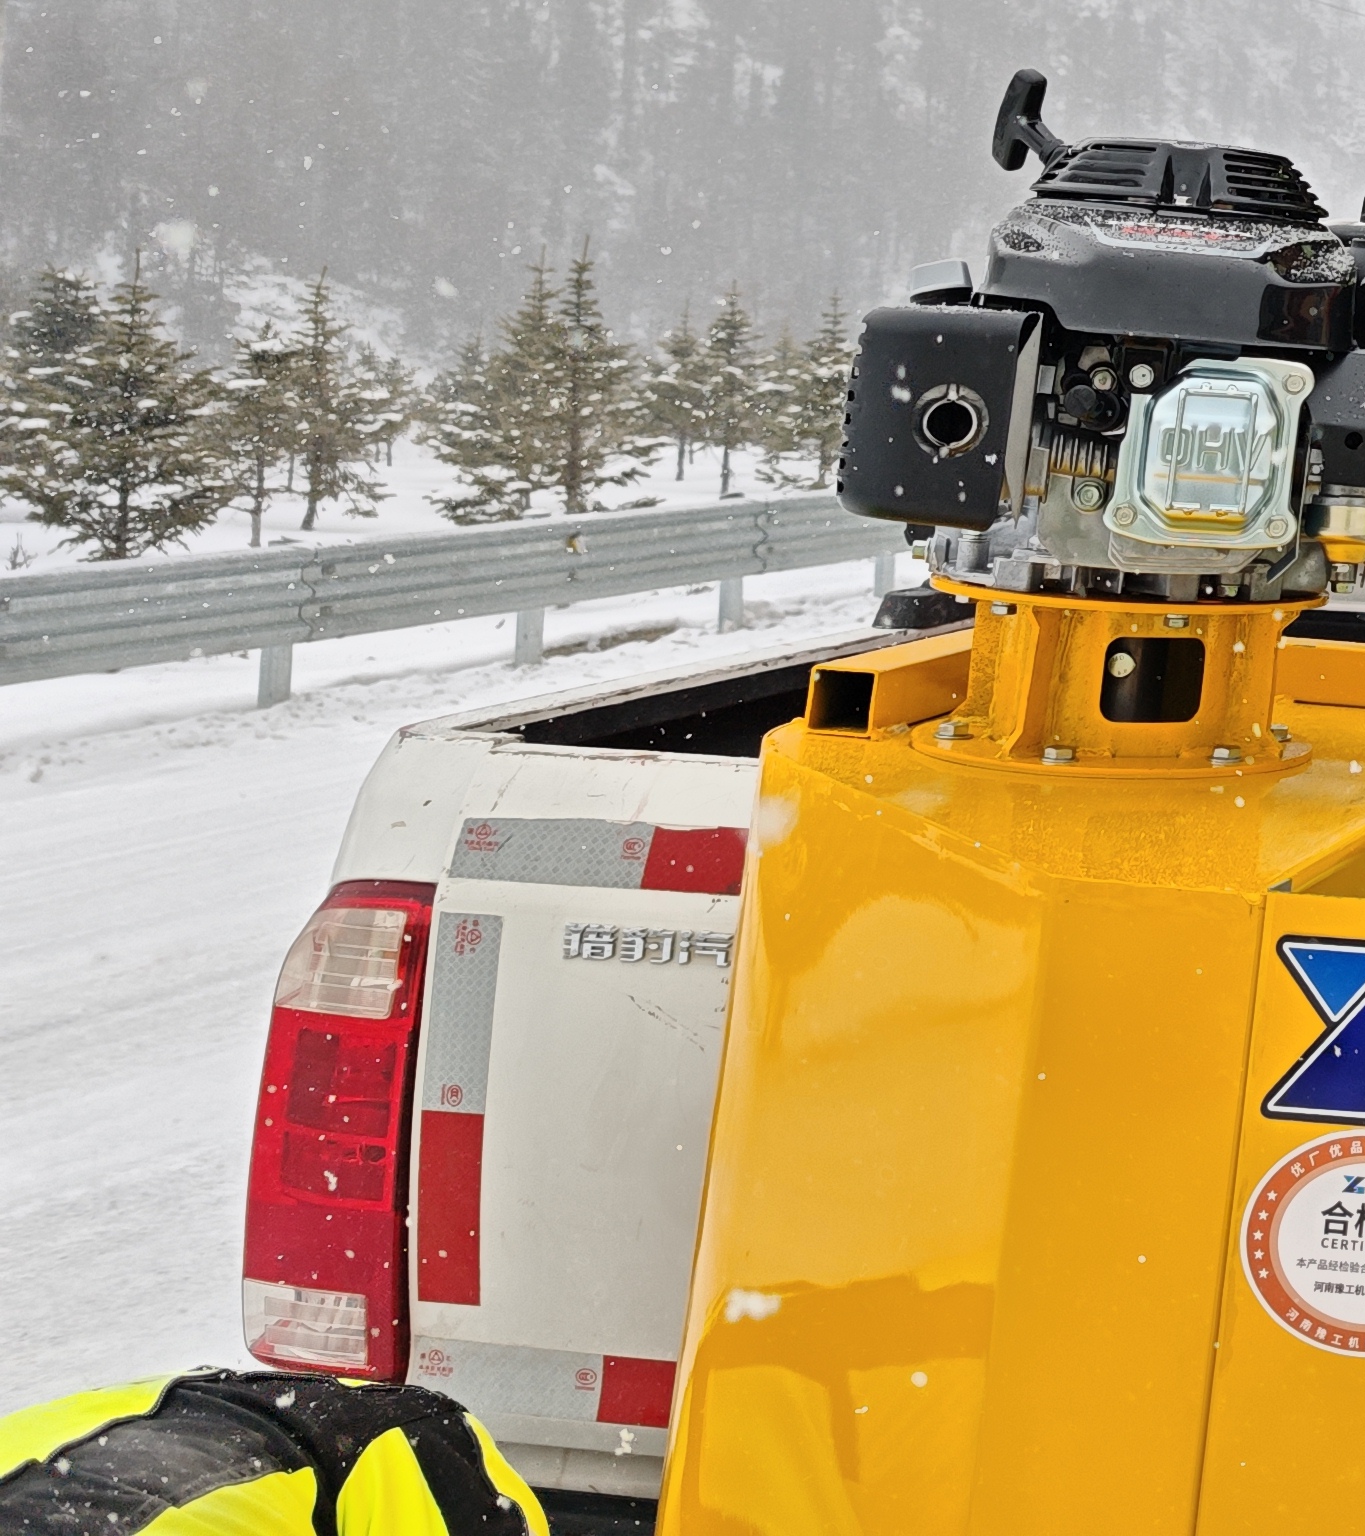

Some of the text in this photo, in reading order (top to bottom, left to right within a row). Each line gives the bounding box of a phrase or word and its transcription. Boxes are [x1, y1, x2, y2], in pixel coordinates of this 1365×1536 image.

[1160, 425, 1268, 471] OHV
[1290, 1140, 1363, 1178] 优厂优品
